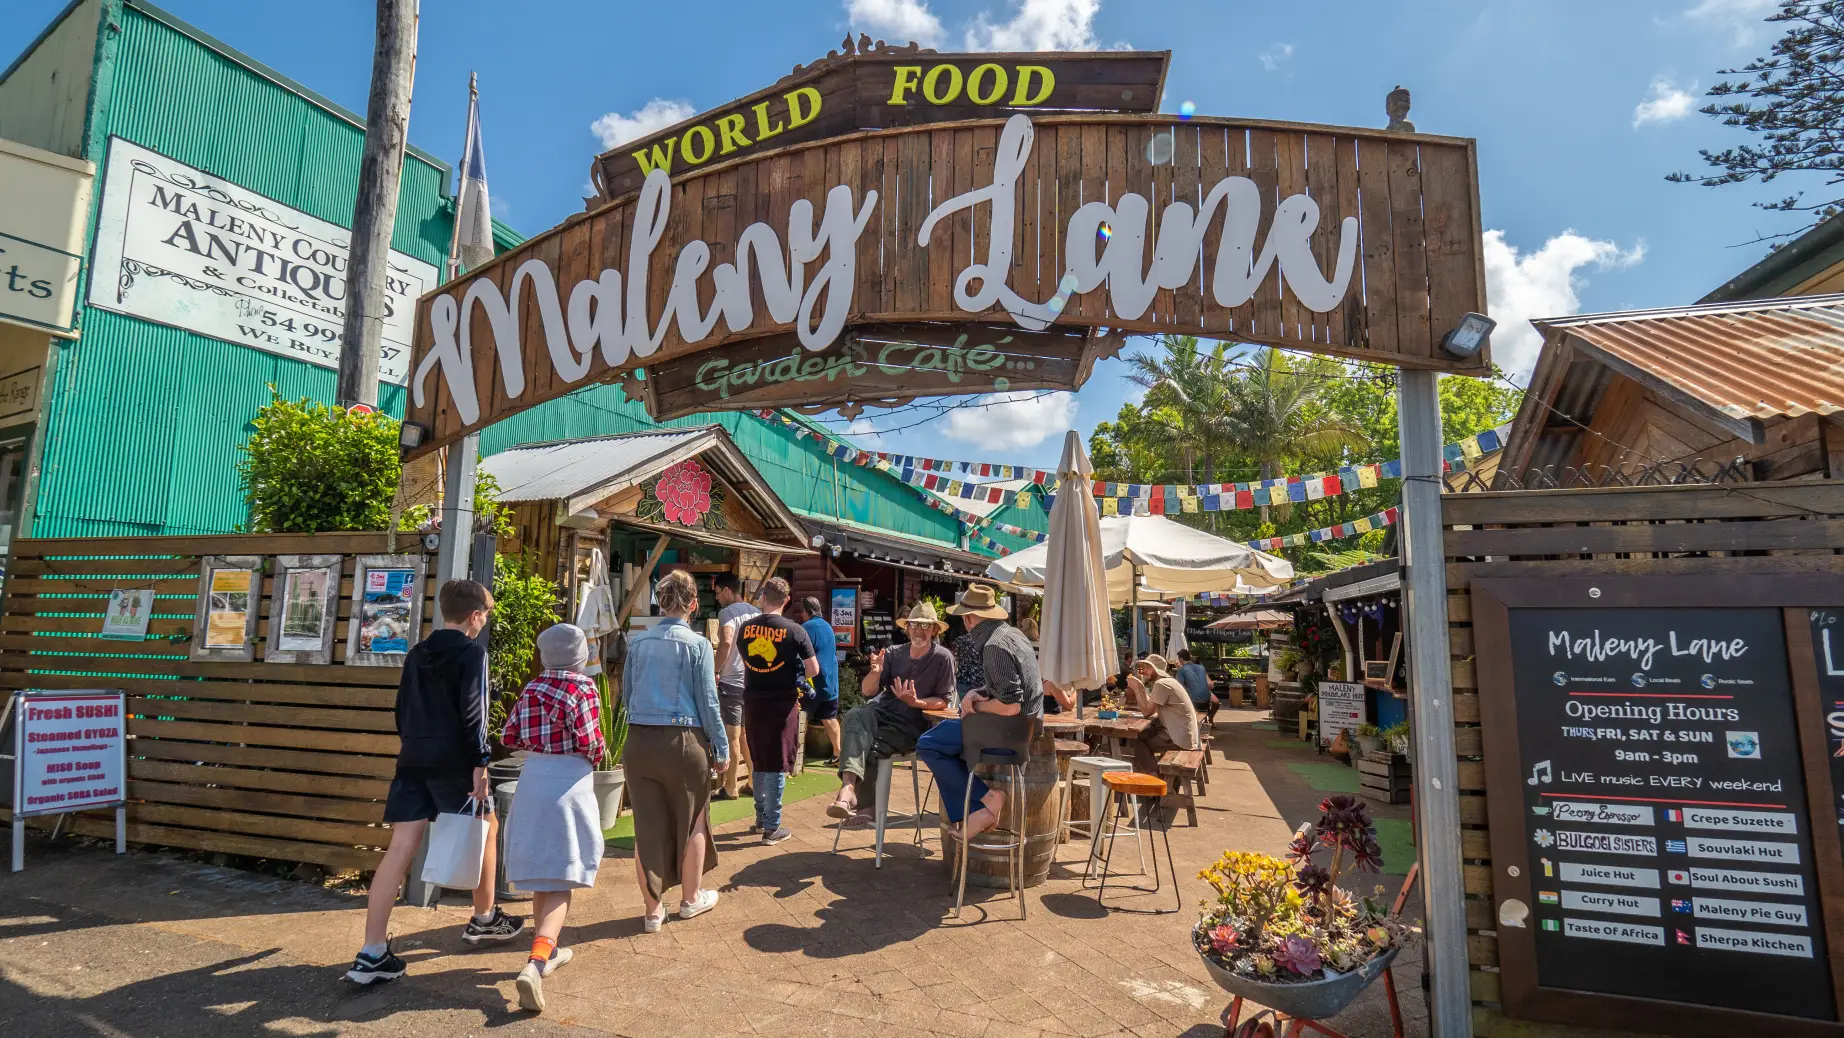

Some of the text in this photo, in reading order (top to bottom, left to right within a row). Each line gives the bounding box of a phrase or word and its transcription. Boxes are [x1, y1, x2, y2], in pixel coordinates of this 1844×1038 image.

[632, 63, 1056, 177] WORLD FOOD
[148, 184, 411, 297] MALENY COURY
[161, 220, 394, 318] ANTIQUS
[413, 113, 1358, 426] Maleny Lane
[261, 310, 297, 334] 54
[236, 324, 280, 344] WE
[288, 338, 334, 359] BUY
[696, 347, 868, 399] Garden
[1549, 630, 1748, 670] Maleny Lane
[28, 704, 118, 721] Fresh SUSHI
[1565, 701, 1739, 724] Opening Hours
[28, 730, 81, 743] Steamed
[1629, 729, 1660, 741] SAT
[1663, 730, 1676, 741] &
[1678, 731, 1713, 742] SUN
[1615, 749, 1650, 762] 9am
[1662, 751, 1698, 765] 3pm
[46, 761, 101, 773] MISO Soup
[1562, 771, 1782, 792] LIVE music EVERY weekend
[27, 793, 65, 805] Organic
[93, 787, 118, 798] Salad
[1691, 813, 1784, 829] Crepe Suzette
[1557, 832, 1656, 853] BULGOGI SISTERS
[1697, 843, 1784, 857] Souvlaki Hut
[1580, 867, 1636, 881] Juice Hut
[1692, 872, 1799, 889] Soul About Sushi
[1581, 895, 1640, 909] Curry Hut
[1699, 904, 1802, 923] Maleny Pie Guy
[1567, 923, 1659, 941] Taste Of Africa
[1700, 933, 1805, 952] Sherpa Kitchen
